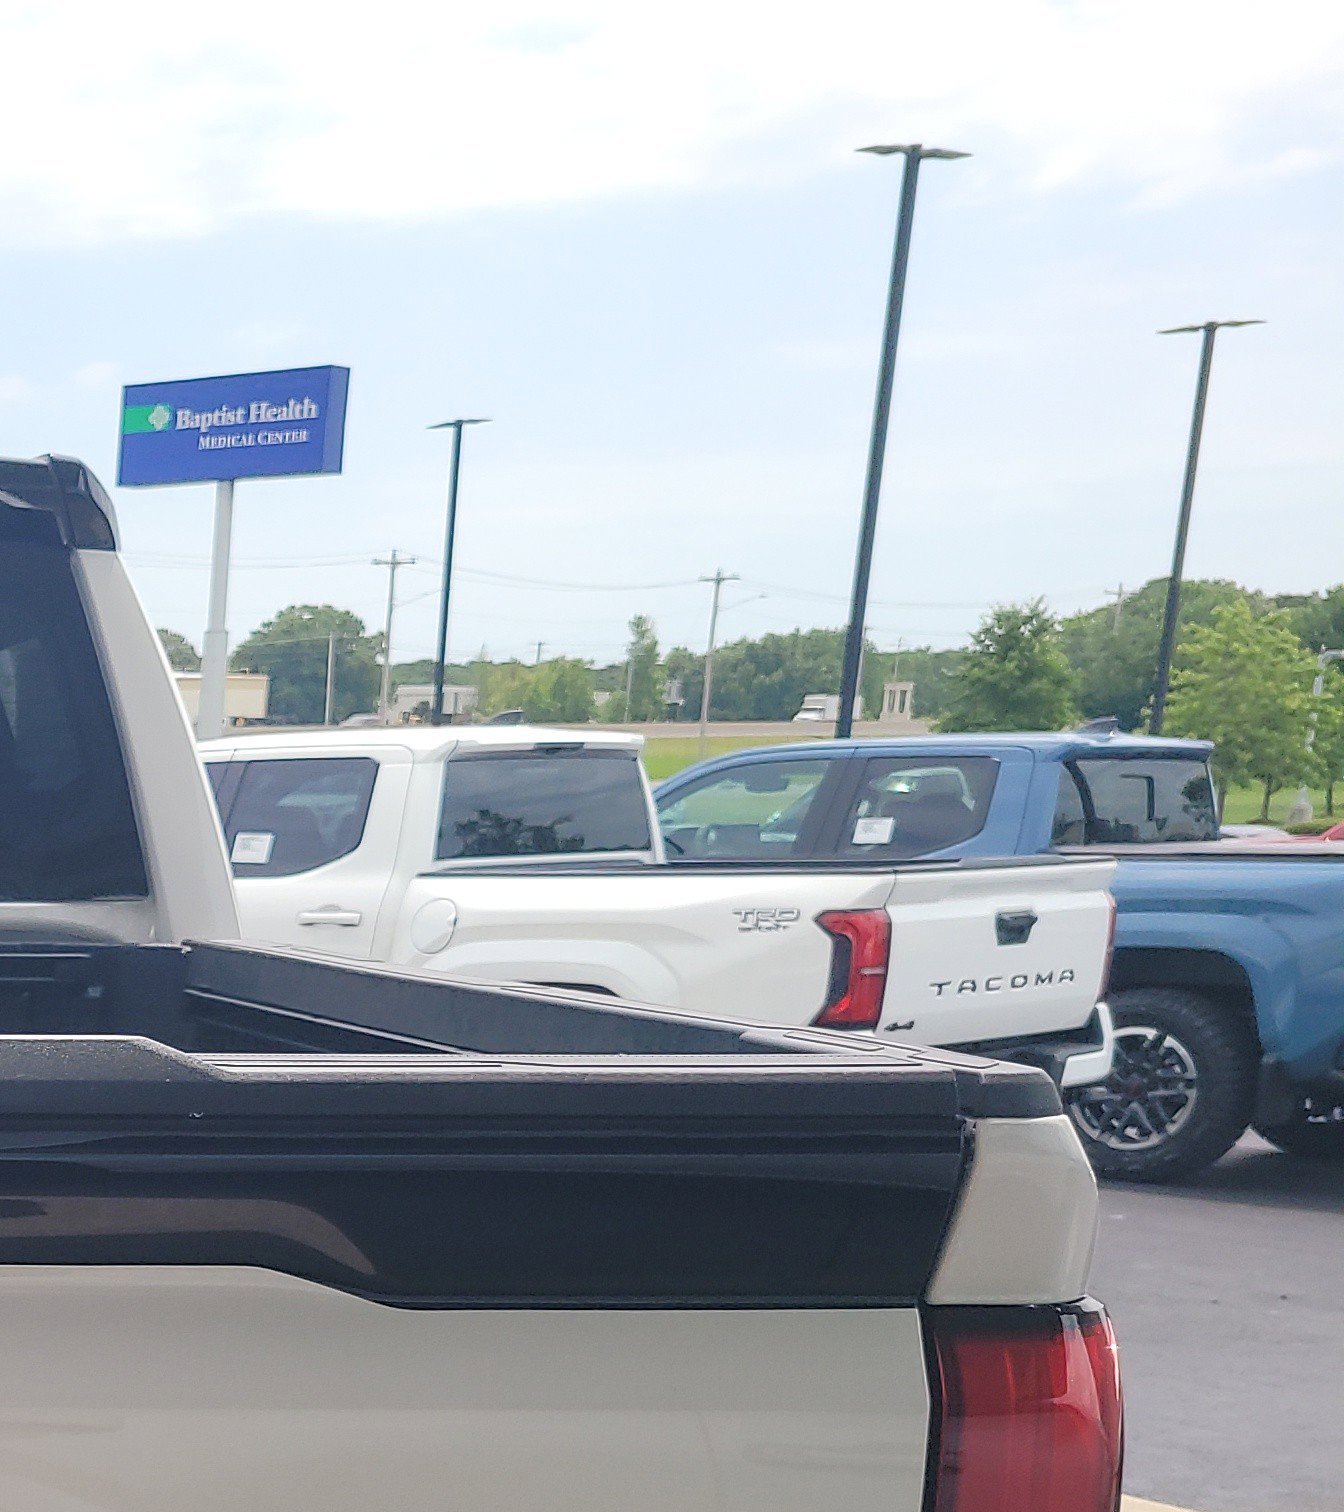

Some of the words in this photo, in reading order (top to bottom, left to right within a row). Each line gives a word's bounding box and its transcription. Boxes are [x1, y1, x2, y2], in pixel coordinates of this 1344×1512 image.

[175, 405, 246, 432] Baptist
[248, 397, 317, 423] Health
[198, 433, 255, 450] MEDICAL
[257, 429, 309, 446] CENTER
[929, 969, 1075, 996] TACOMA
